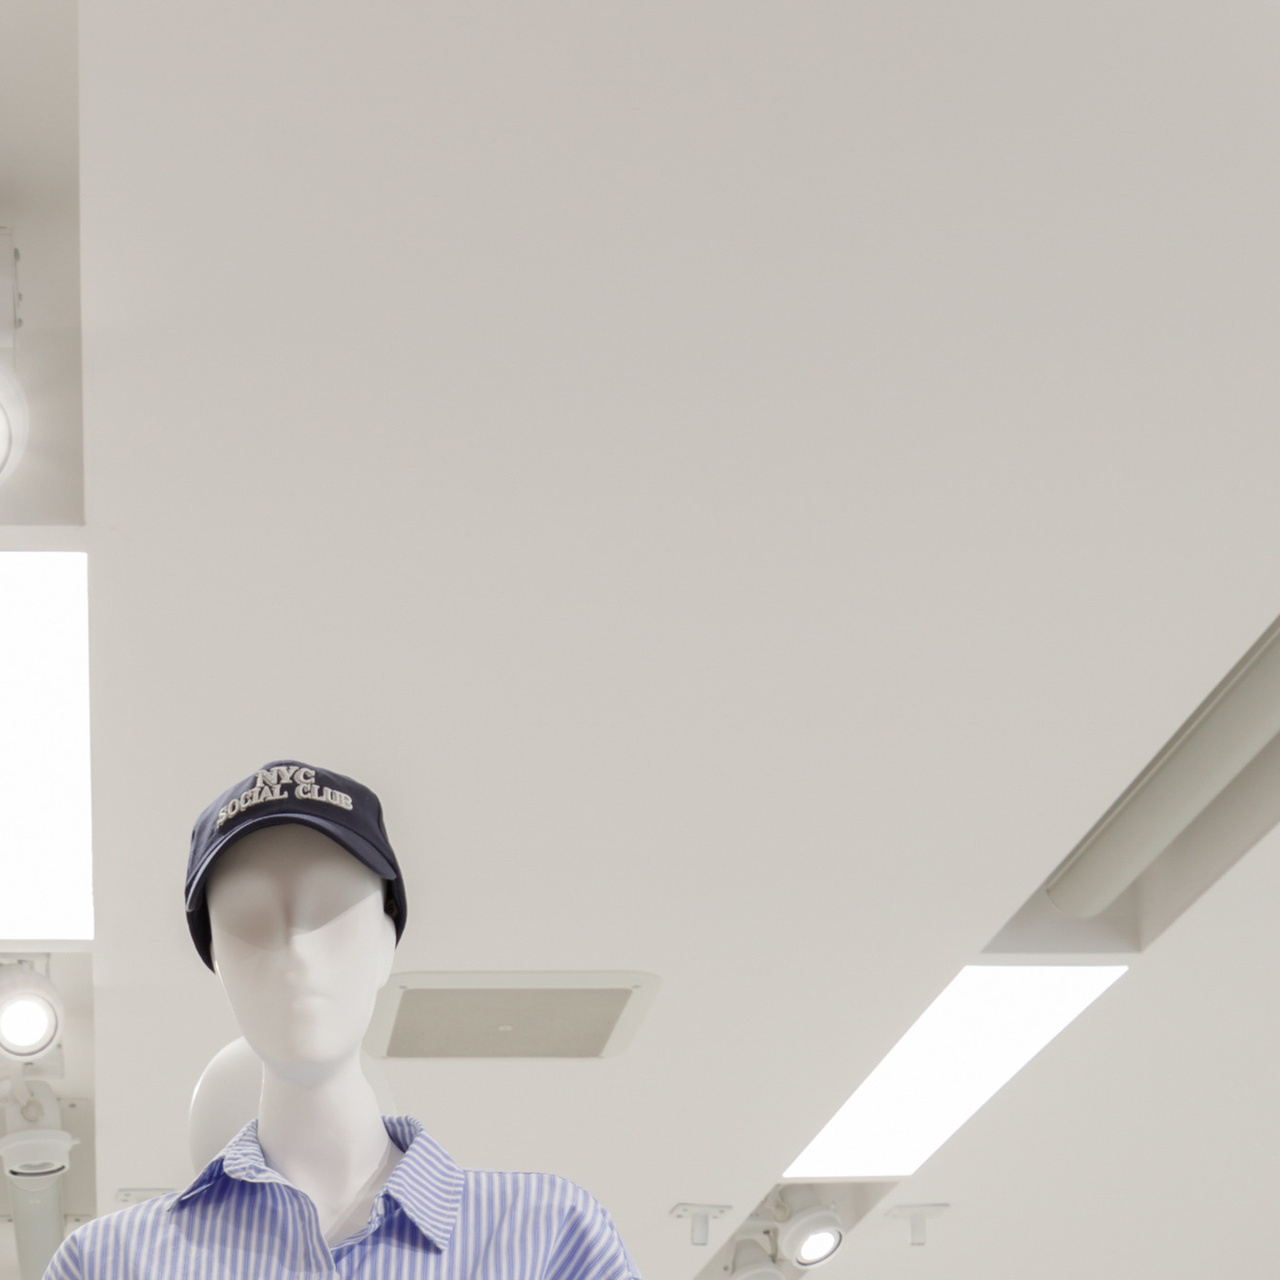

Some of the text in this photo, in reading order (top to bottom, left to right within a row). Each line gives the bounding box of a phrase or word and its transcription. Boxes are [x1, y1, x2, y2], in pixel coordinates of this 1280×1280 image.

[256, 766, 316, 788] NYC
[216, 783, 354, 829] SOCIAL CLUB
